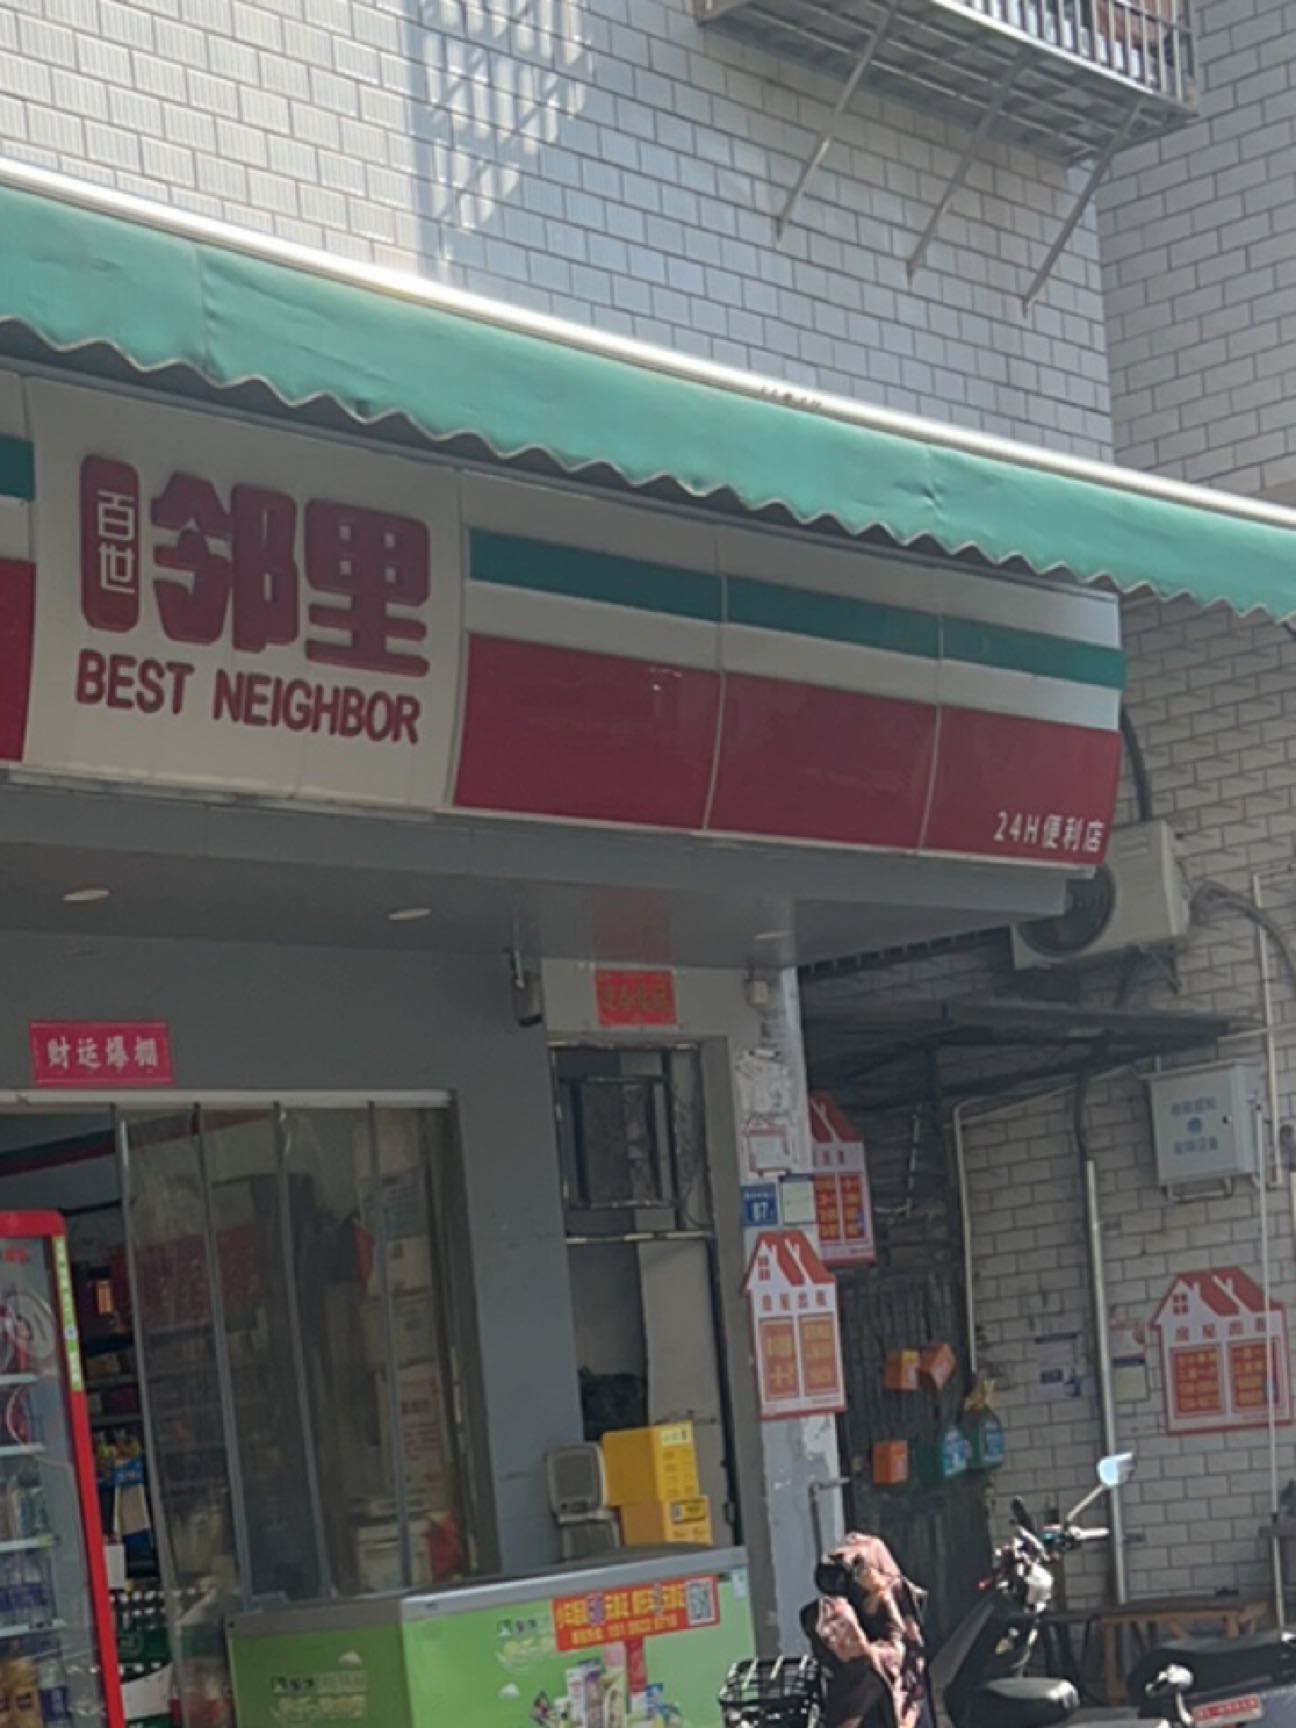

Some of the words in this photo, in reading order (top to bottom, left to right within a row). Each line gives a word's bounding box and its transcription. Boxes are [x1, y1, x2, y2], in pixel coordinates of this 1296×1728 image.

[150, 470, 431, 678] 邻里
[75, 648, 195, 715] BEST
[212, 668, 421, 746] NEIGHBOR
[993, 810, 1106, 853] 24H便利店
